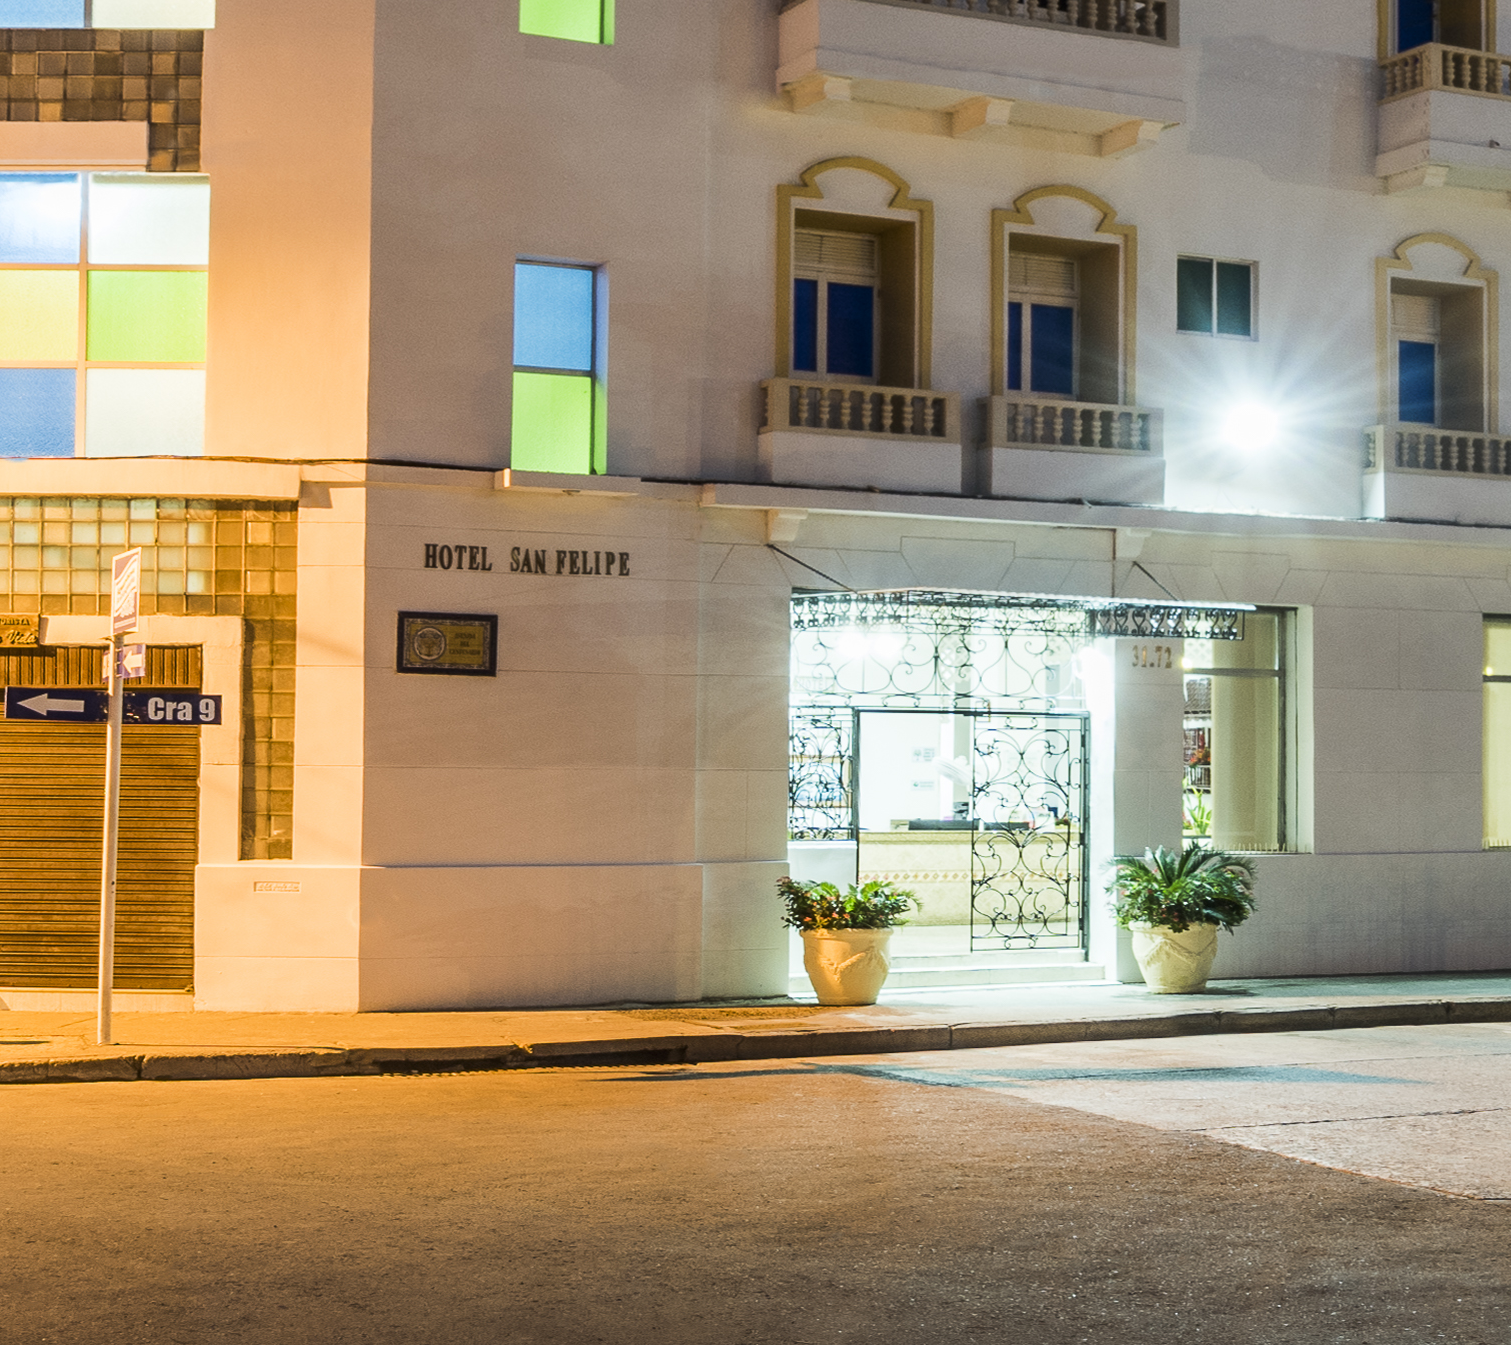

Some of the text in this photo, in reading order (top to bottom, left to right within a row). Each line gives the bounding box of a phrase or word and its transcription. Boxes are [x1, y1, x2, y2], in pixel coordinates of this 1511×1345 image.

[424, 543, 631, 577] HOTEL SAN FELIPE
[7, 630, 38, 644] Vida
[147, 696, 216, 722] Cra 9
